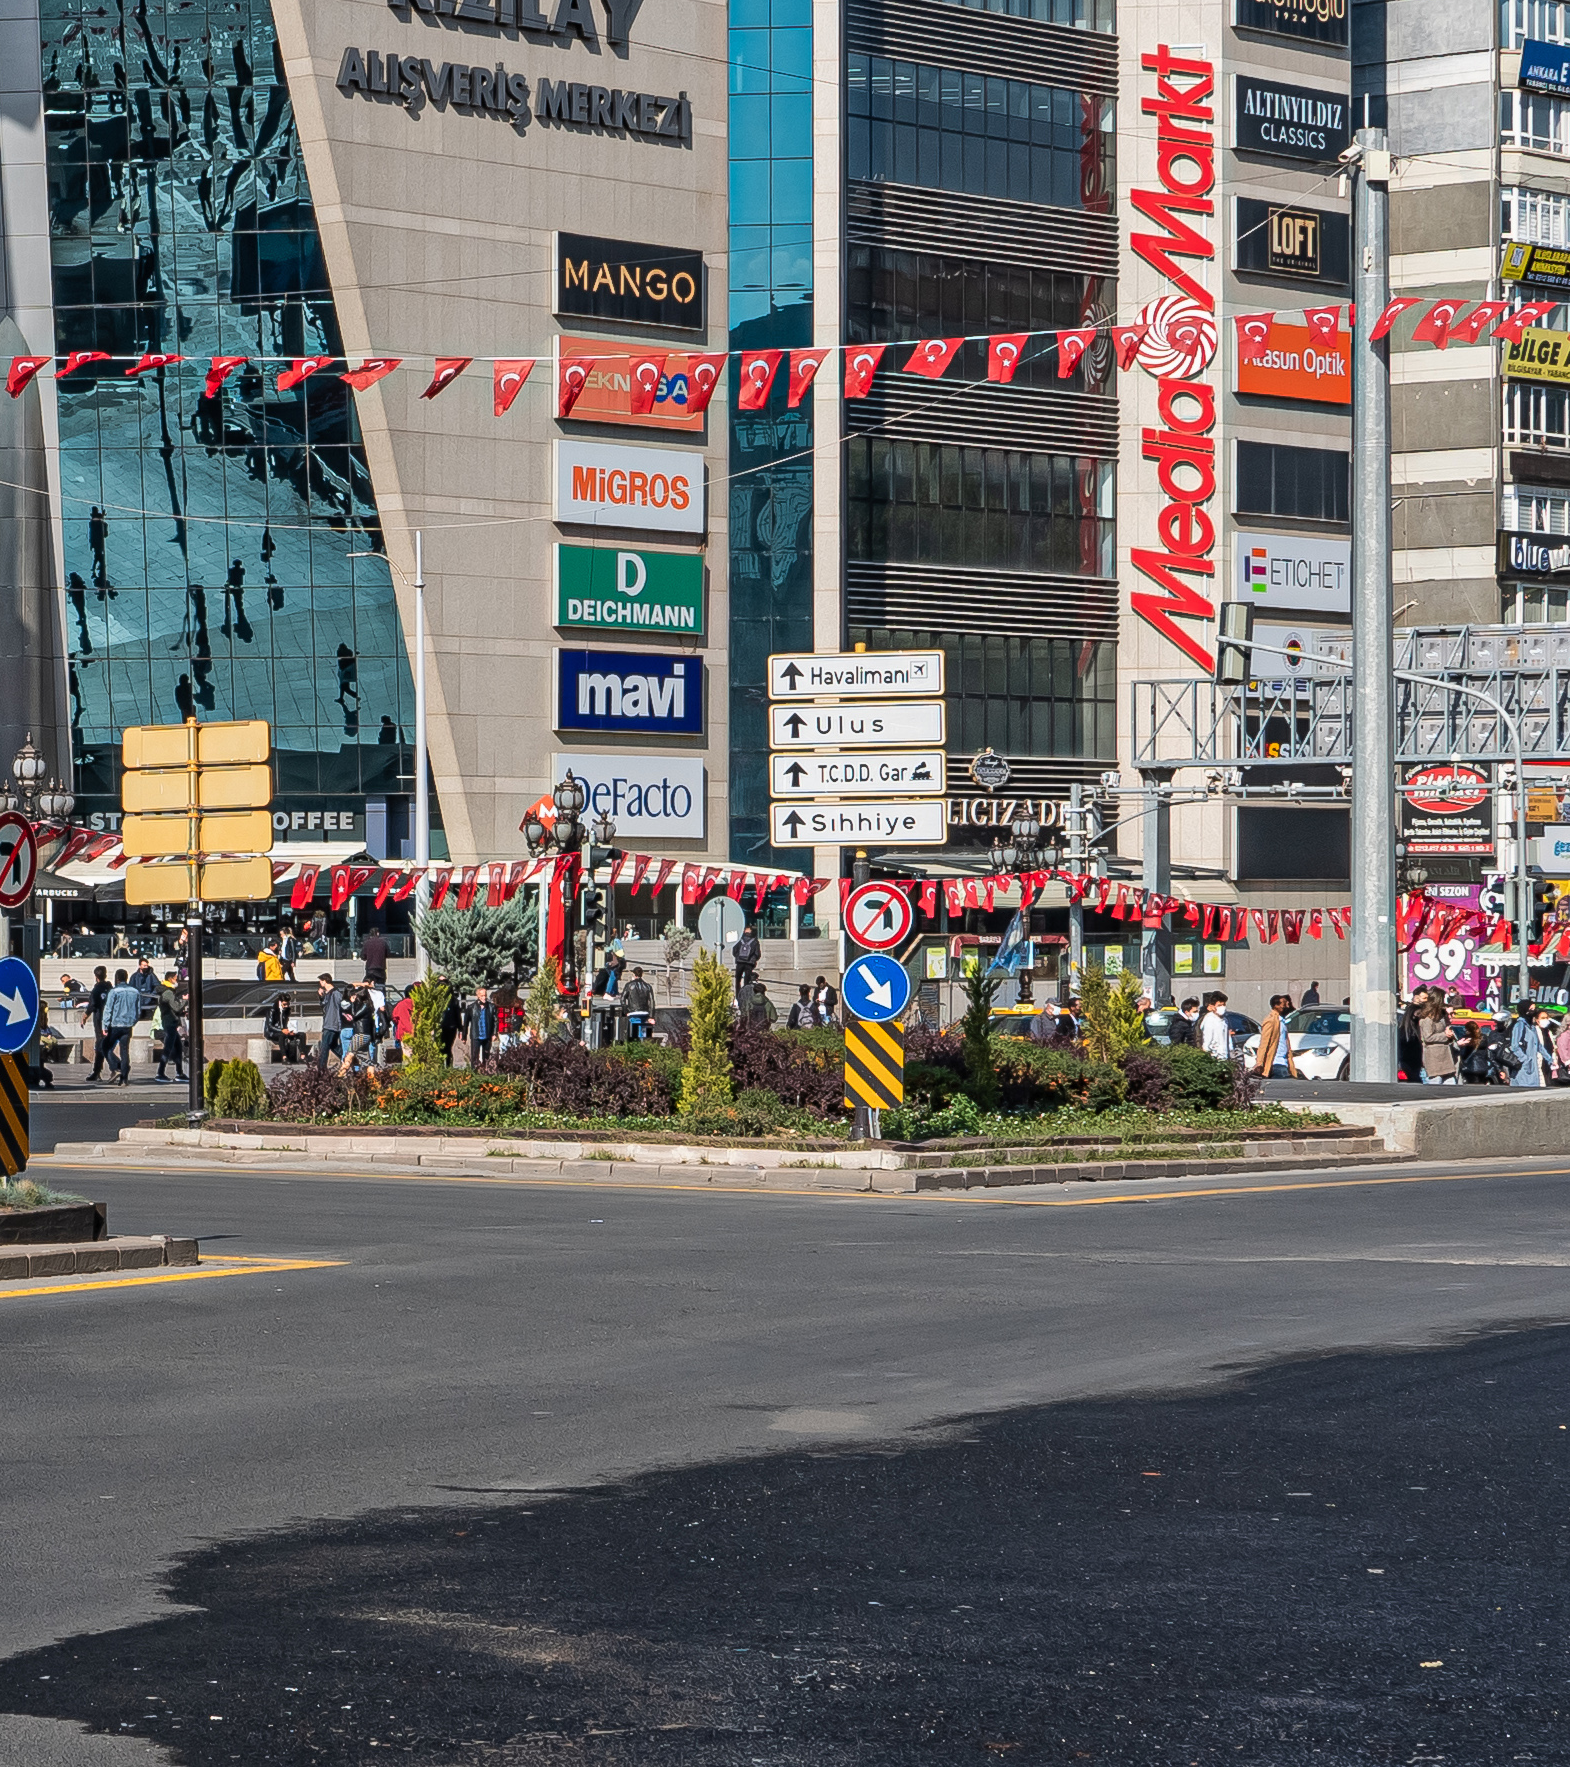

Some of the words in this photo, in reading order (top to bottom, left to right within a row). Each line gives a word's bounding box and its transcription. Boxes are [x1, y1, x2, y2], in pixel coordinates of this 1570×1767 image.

[1275, 9, 1307, 23] 1924
[1527, 65, 1558, 82] ANKARA
[336, 45, 530, 123] ALIŞVERİŞ
[535, 77, 692, 140] MERKEZİ
[1244, 88, 1342, 131] ALTINYILDIZ
[1260, 122, 1326, 150] CLASSICS
[1130, 44, 1215, 310] Markt
[1272, 215, 1316, 258] LOFT
[565, 257, 696, 304] MANGO
[1303, 347, 1346, 378] Optik
[1508, 331, 1561, 366] BİLGE
[1130, 375, 1215, 674] Media
[617, 551, 647, 596] D
[1271, 557, 1342, 591] ETICHET
[567, 597, 695, 628] DEICHMANN
[578, 663, 685, 719] mavi
[811, 666, 909, 686] Havalimanı
[816, 716, 884, 734] Ulus
[818, 764, 873, 783] T.C.D.D.
[879, 763, 908, 782] Gar
[572, 775, 692, 819] DeFacto
[273, 811, 354, 831] OFFEE
[812, 813, 916, 836] Sıhhiye
[1440, 886, 1469, 897] SEZON
